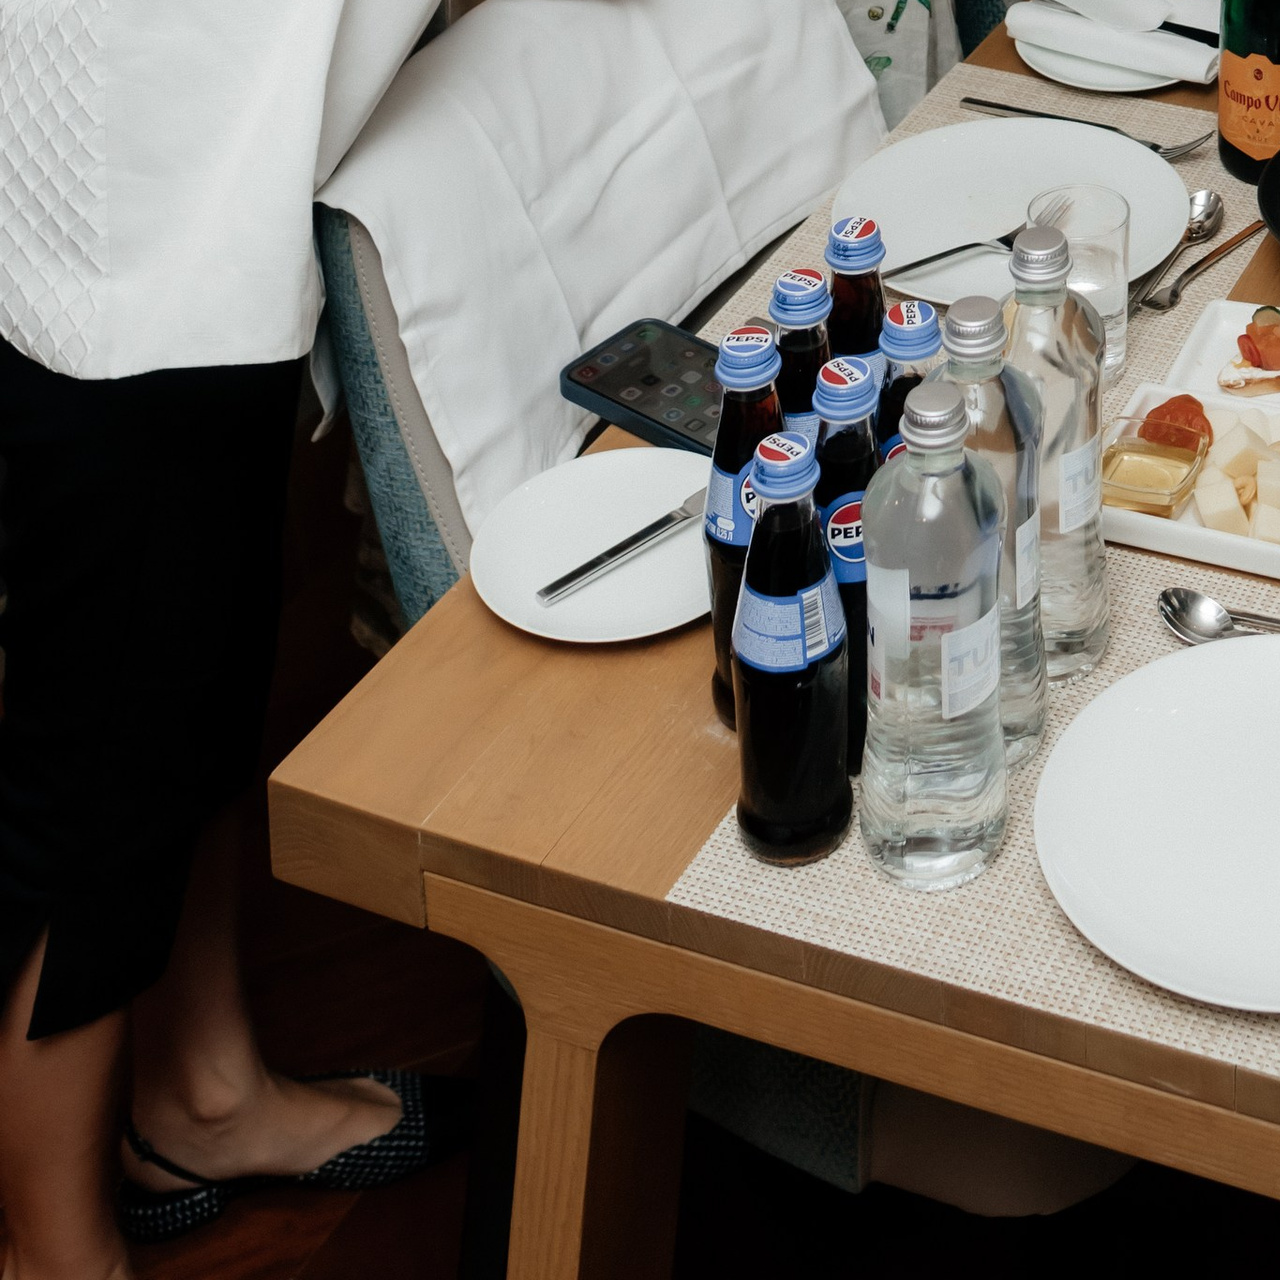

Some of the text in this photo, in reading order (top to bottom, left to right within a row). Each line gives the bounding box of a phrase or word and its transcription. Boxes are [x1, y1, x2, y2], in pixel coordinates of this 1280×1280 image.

[1223, 80, 1262, 112] Campo
[1241, 115, 1275, 127] CAVA
[842, 217, 867, 238] PEPSI
[782, 272, 818, 288] PEPSI
[905, 301, 916, 325] PEPSI
[725, 335, 769, 344] PEPSI
[830, 360, 860, 382] PEPSI
[765, 436, 801, 457] PEPSI
[830, 525, 863, 540] PEP
